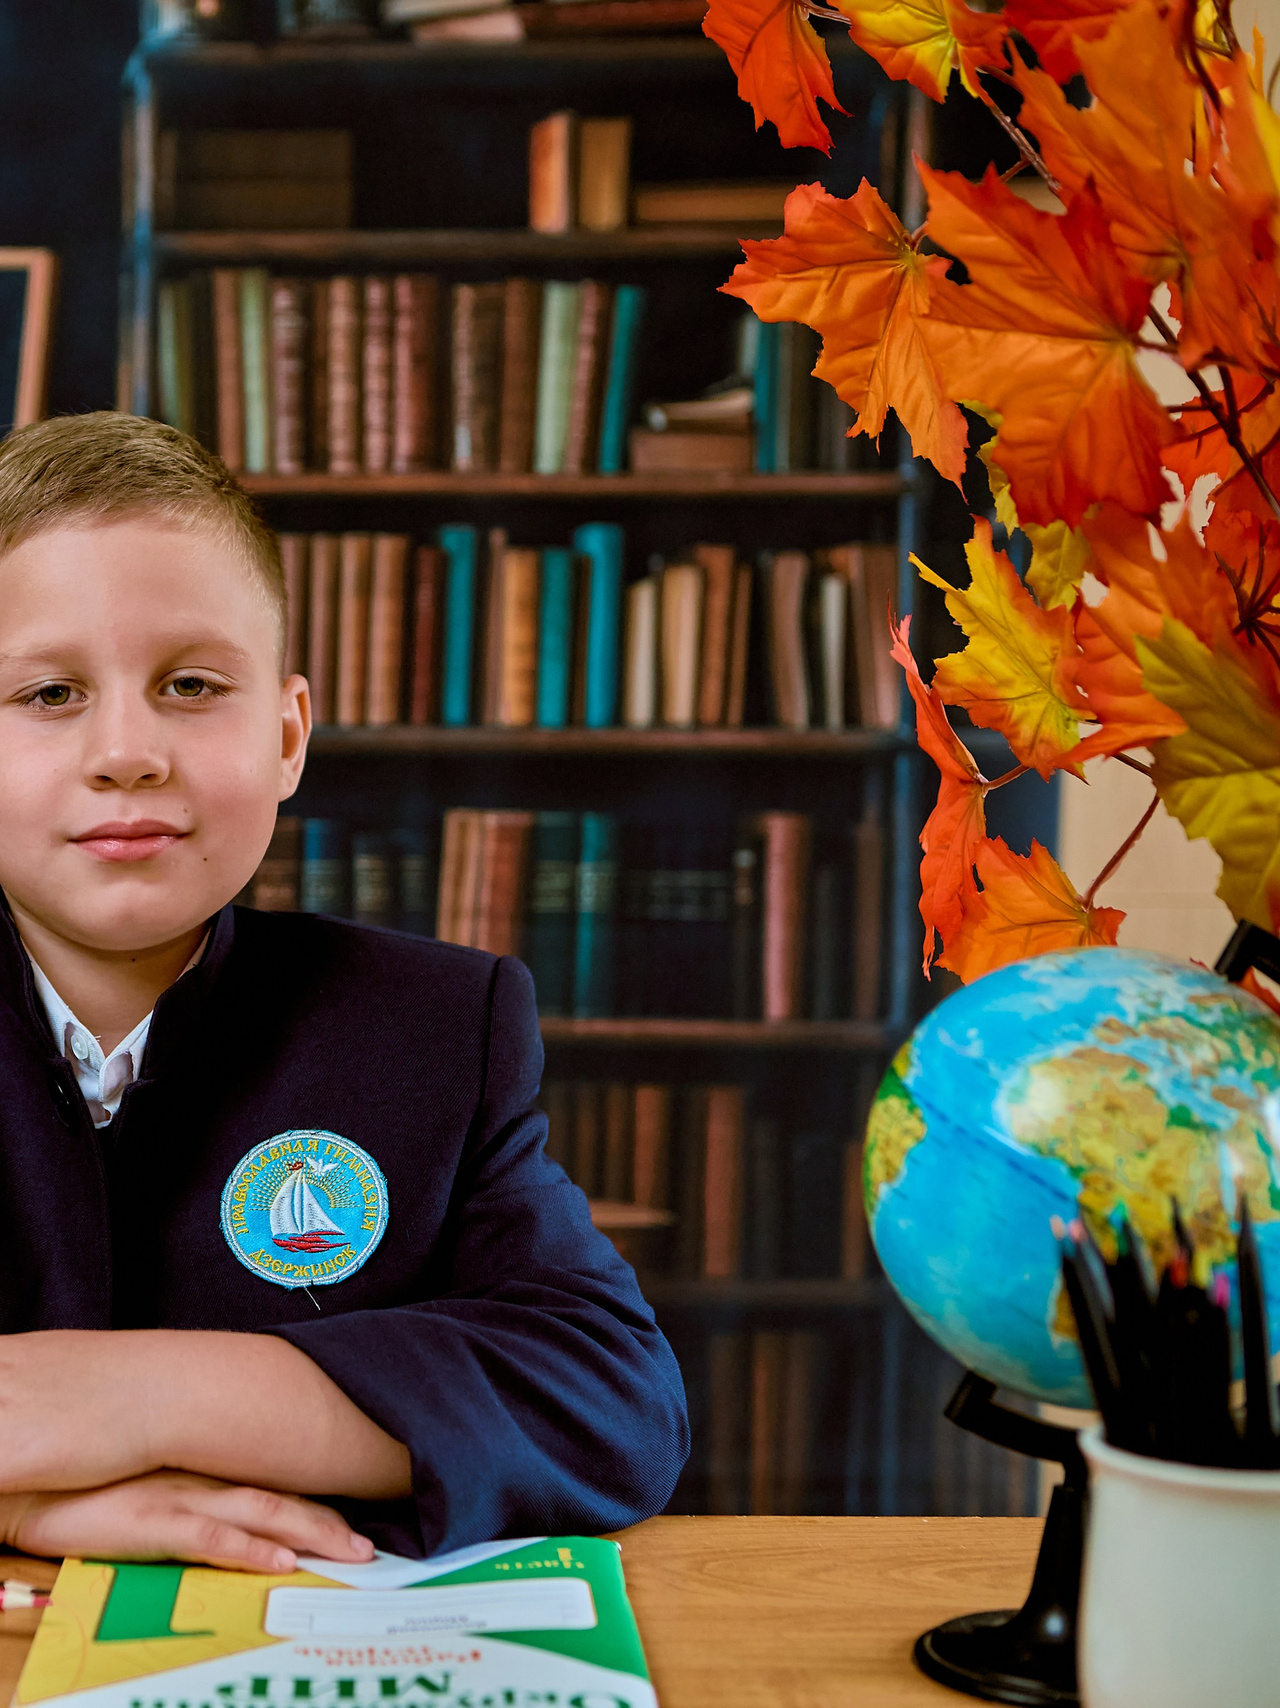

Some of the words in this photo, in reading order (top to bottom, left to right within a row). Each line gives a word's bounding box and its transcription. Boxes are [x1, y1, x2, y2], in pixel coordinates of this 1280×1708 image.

[231, 1140, 319, 1235] ПРАВОСЛАВНАЯ
[324, 1143, 378, 1231] ГИМНАЗИЯ
[81, 1559, 216, 1642] 1
